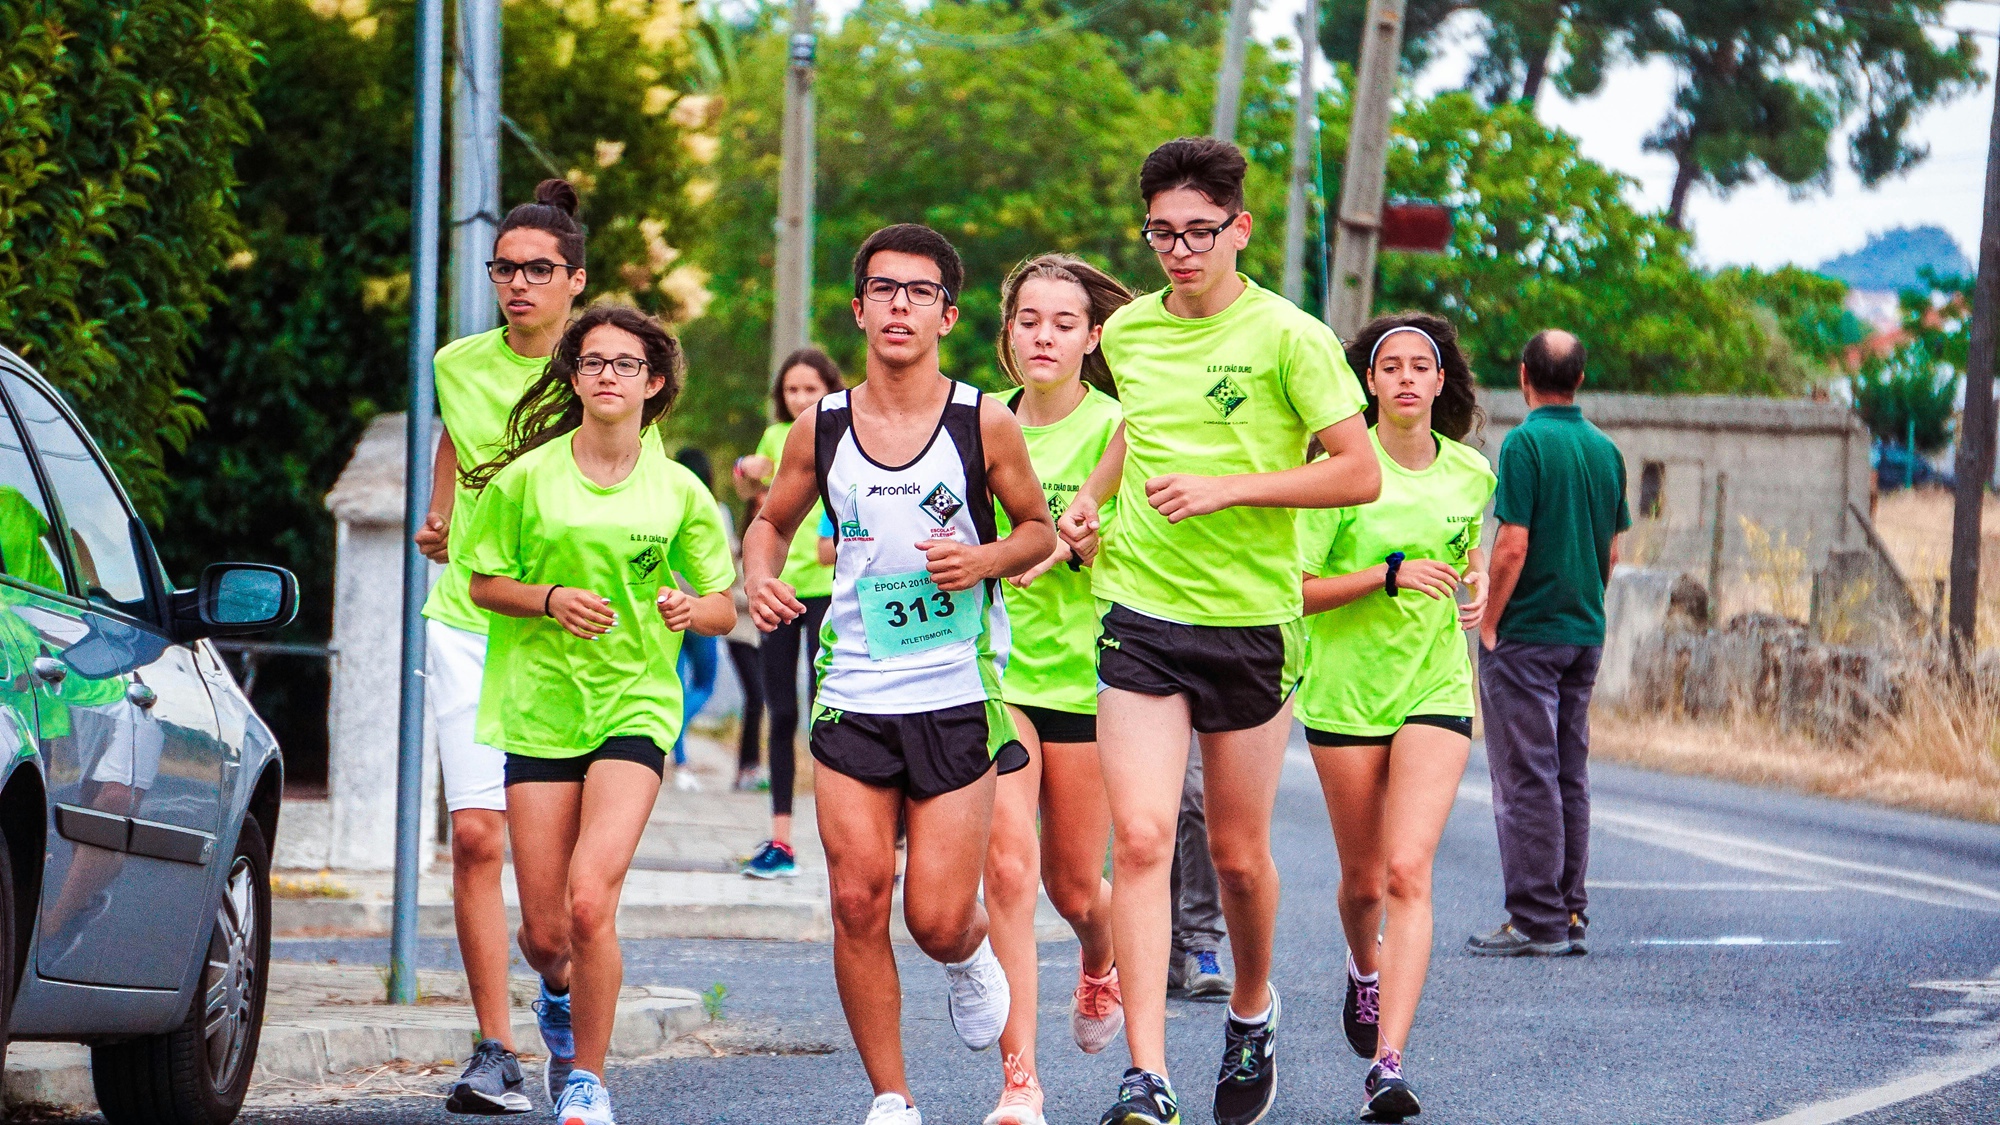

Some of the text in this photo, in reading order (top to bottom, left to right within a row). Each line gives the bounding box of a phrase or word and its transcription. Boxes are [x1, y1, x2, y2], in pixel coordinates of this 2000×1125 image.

[874, 581, 907, 592] ÉPOCA
[885, 591, 955, 628] 313
[901, 628, 953, 645] ATLETISMOITA
